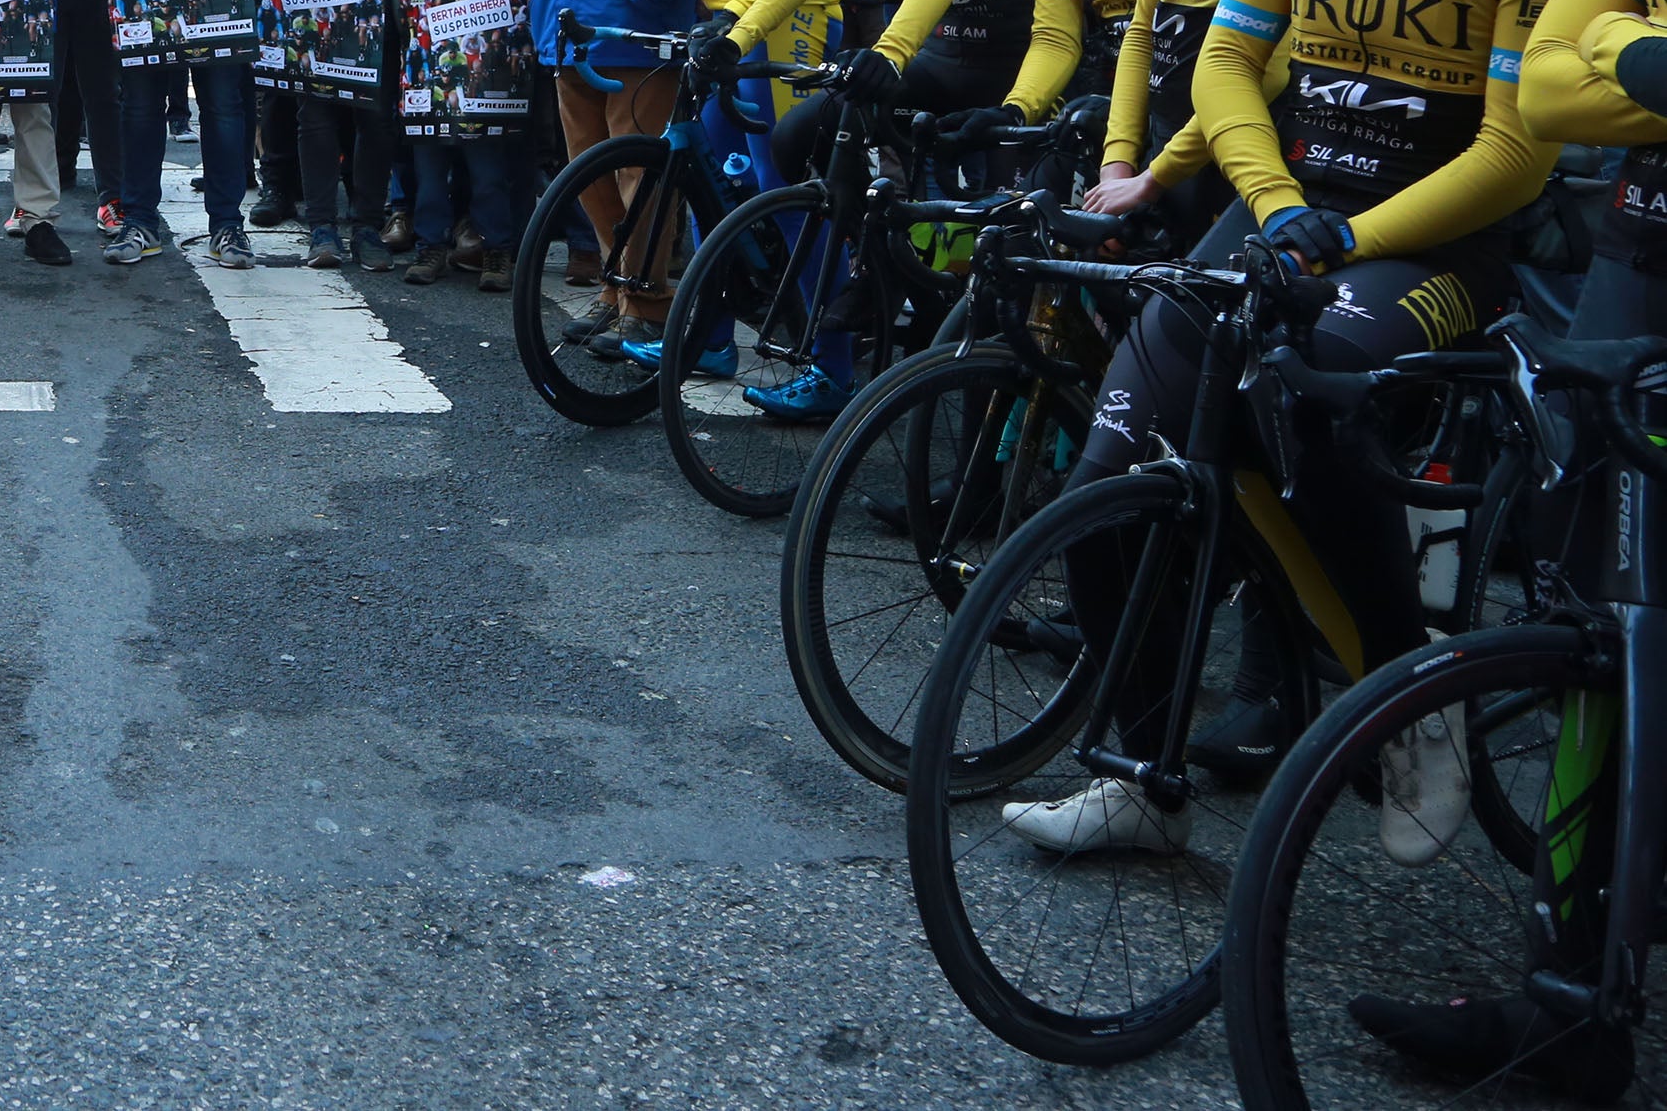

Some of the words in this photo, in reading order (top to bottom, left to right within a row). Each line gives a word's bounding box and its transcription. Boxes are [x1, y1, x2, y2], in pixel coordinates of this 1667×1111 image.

[431, 6, 467, 23] BERTAN
[433, 10, 509, 36] SUSPENDIDO
[199, 21, 252, 34] PNEUMAX
[326, 66, 377, 80] PNEUMAX
[1401, 59, 1476, 86] GROUP
[477, 101, 527, 110] PNEUMAX
[1092, 410, 1136, 444] Spiuk
[1617, 470, 1633, 573] ORBEA
